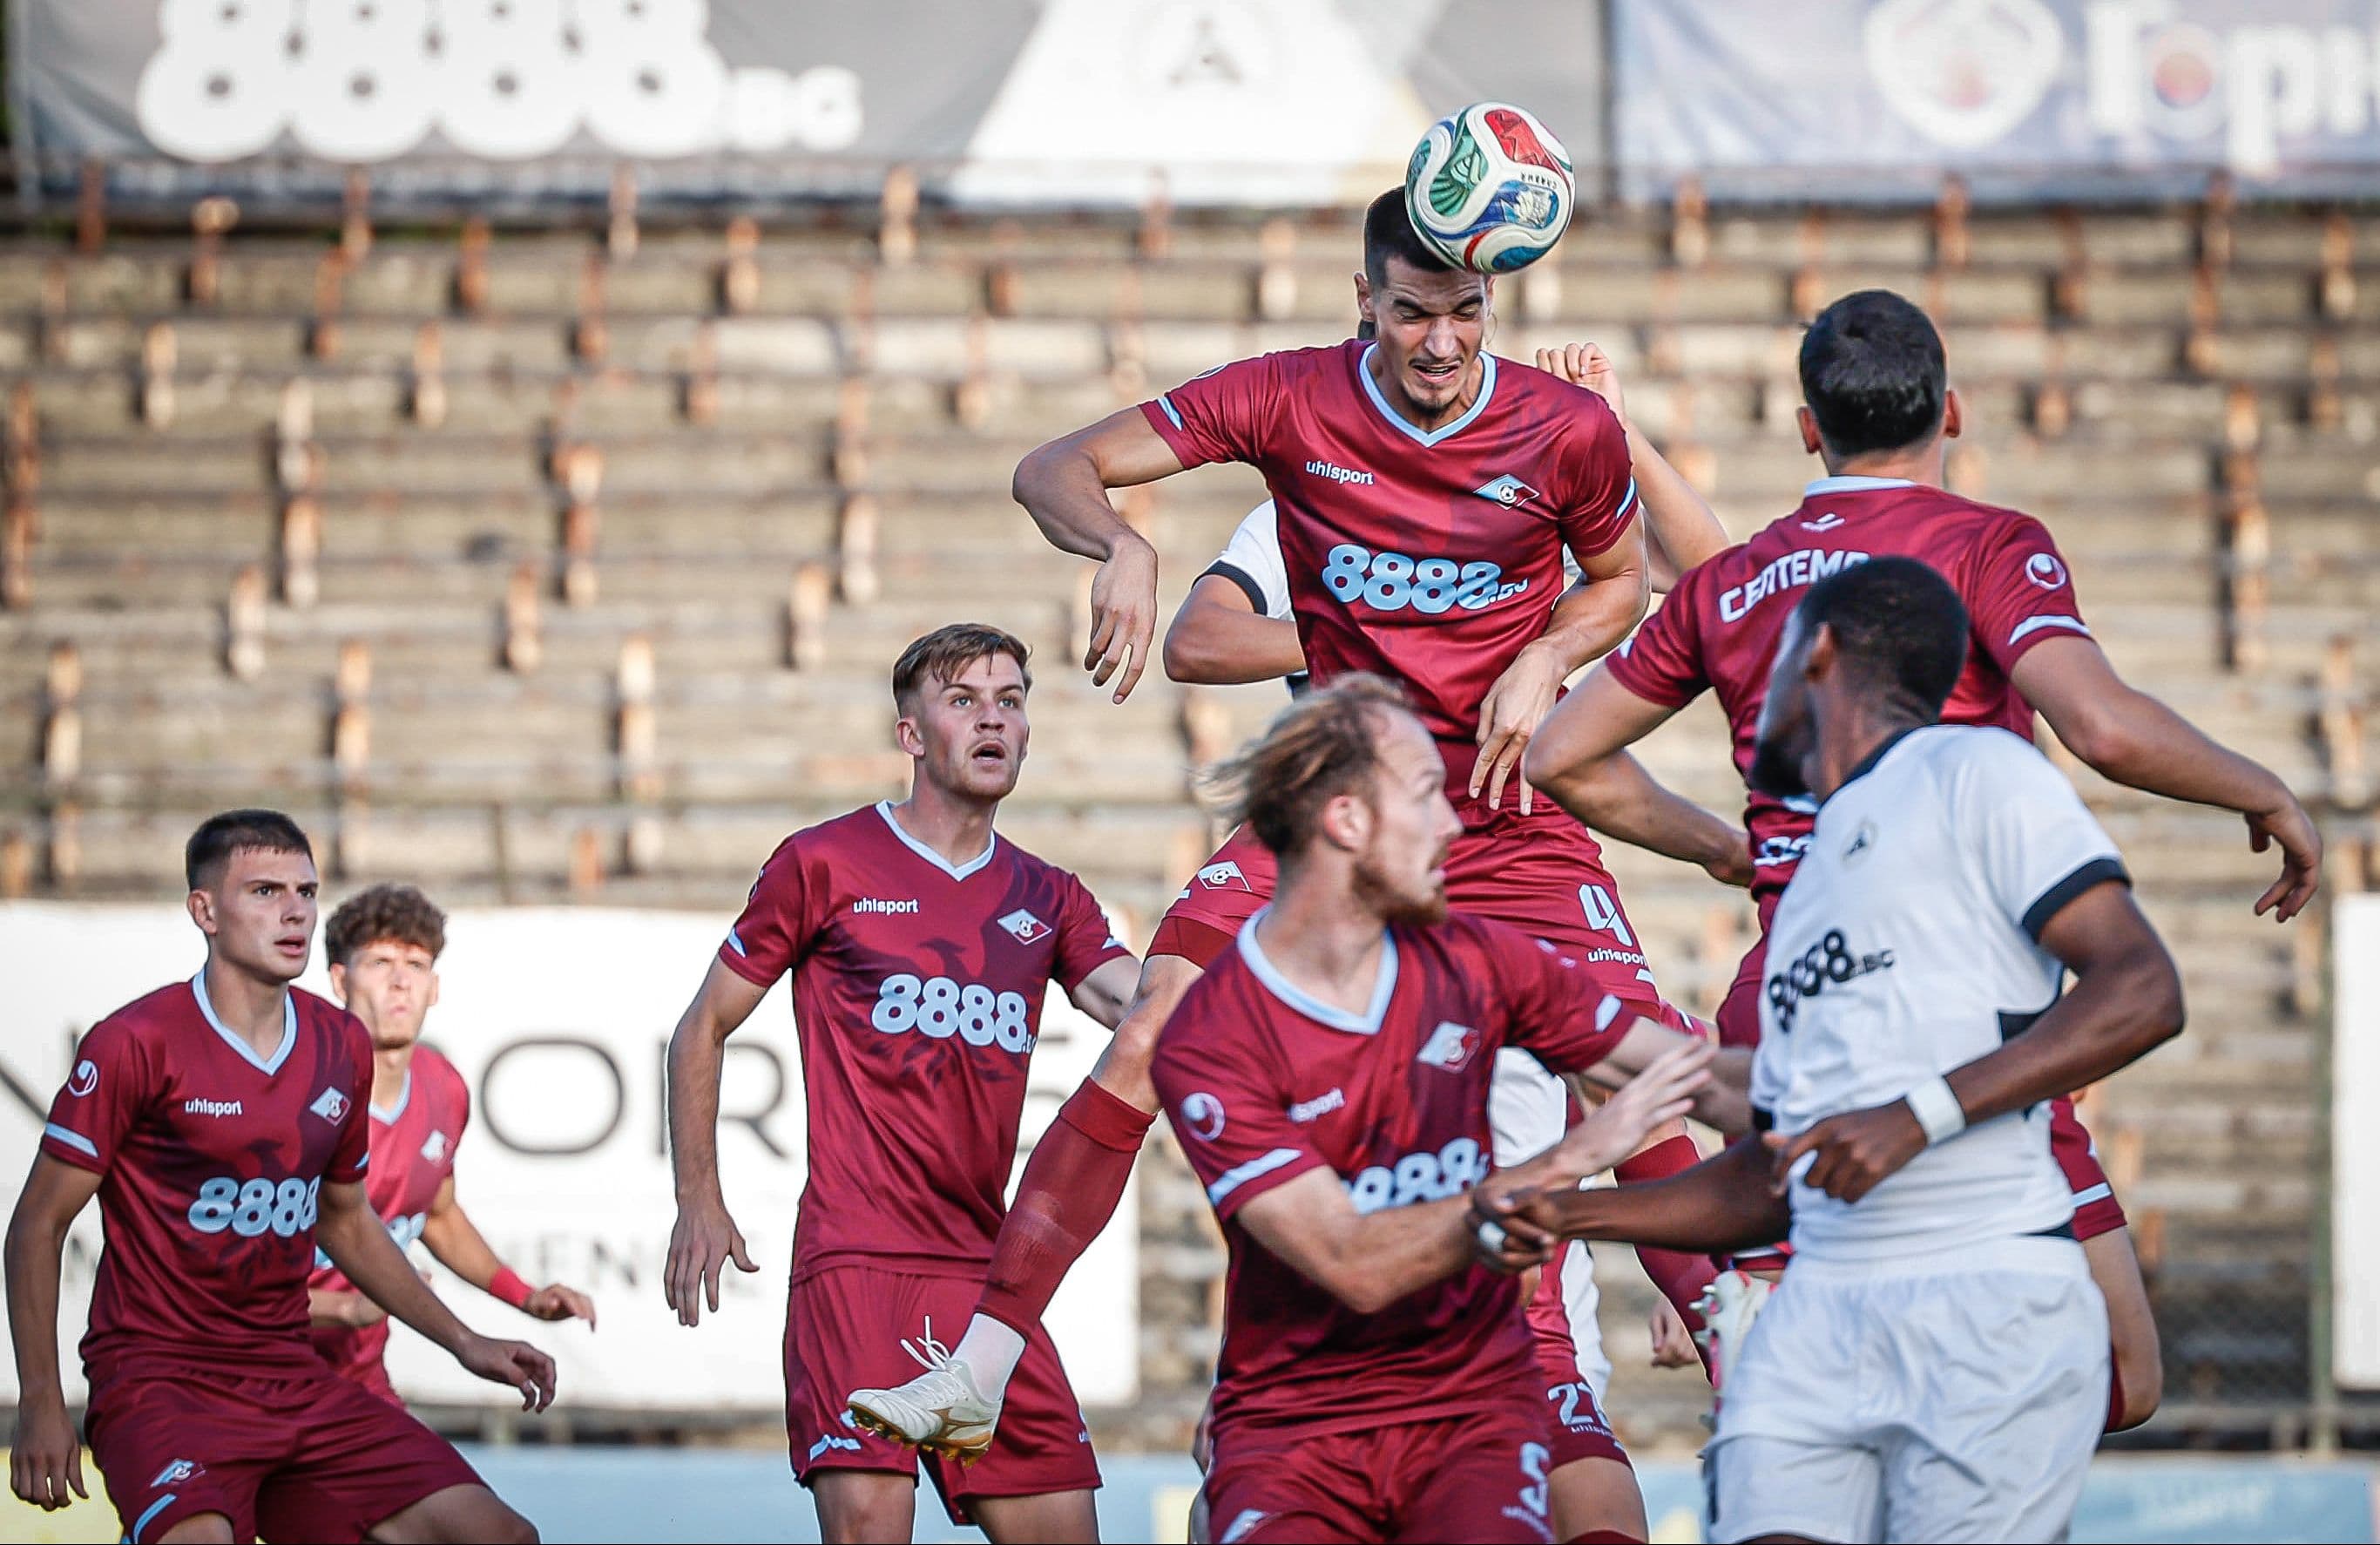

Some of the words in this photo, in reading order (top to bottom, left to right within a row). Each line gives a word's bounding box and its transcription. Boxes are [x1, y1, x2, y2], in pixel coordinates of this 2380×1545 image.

[1306, 459, 1374, 485] uhlsport
[853, 897, 919, 916] uhlsport
[1578, 884, 1633, 947] 4
[185, 1097, 243, 1119] uhlsport
